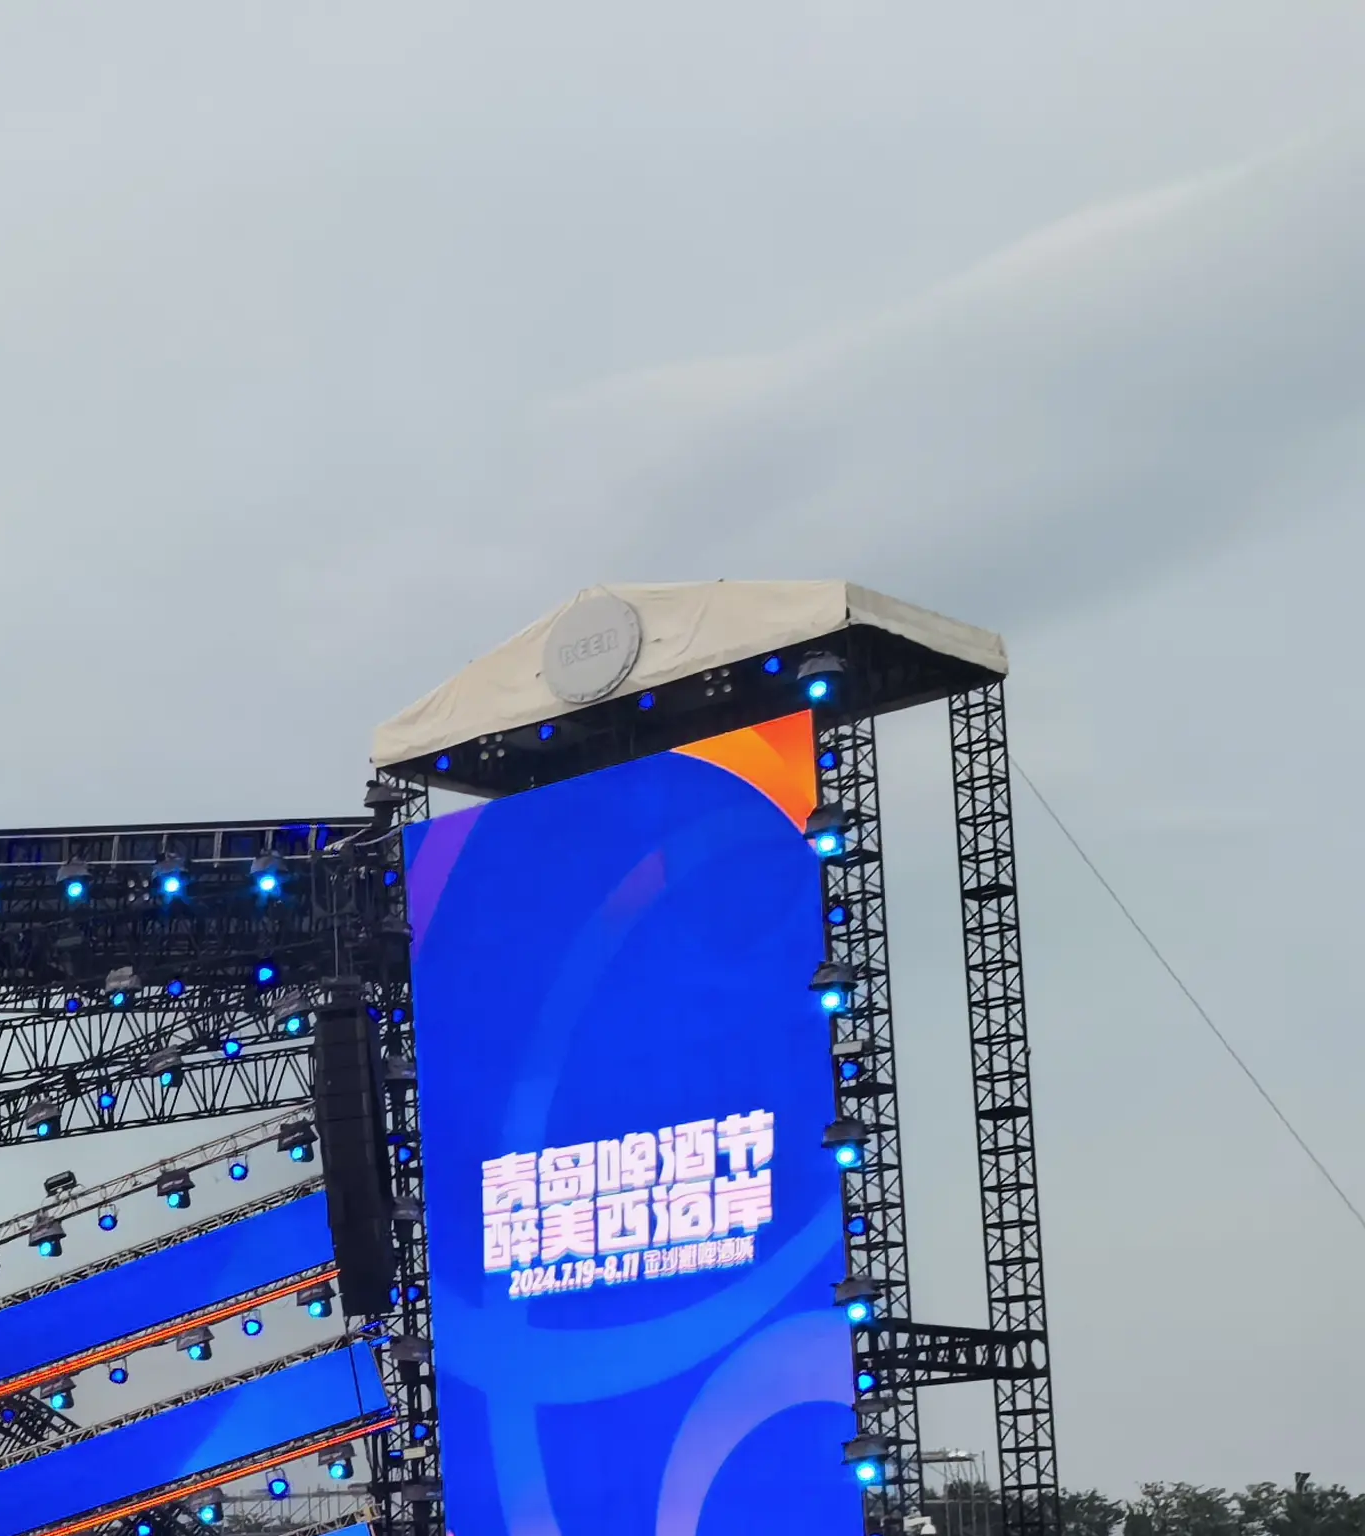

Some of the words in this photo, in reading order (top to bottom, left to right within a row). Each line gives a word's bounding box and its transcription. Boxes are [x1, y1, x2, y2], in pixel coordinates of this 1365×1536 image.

[559, 628, 619, 666] BEER
[481, 1108, 775, 1213] 青岛啤酒节
[483, 1169, 773, 1270] 醉美西海岸
[509, 1254, 640, 1299] 2024.7.19-8.11
